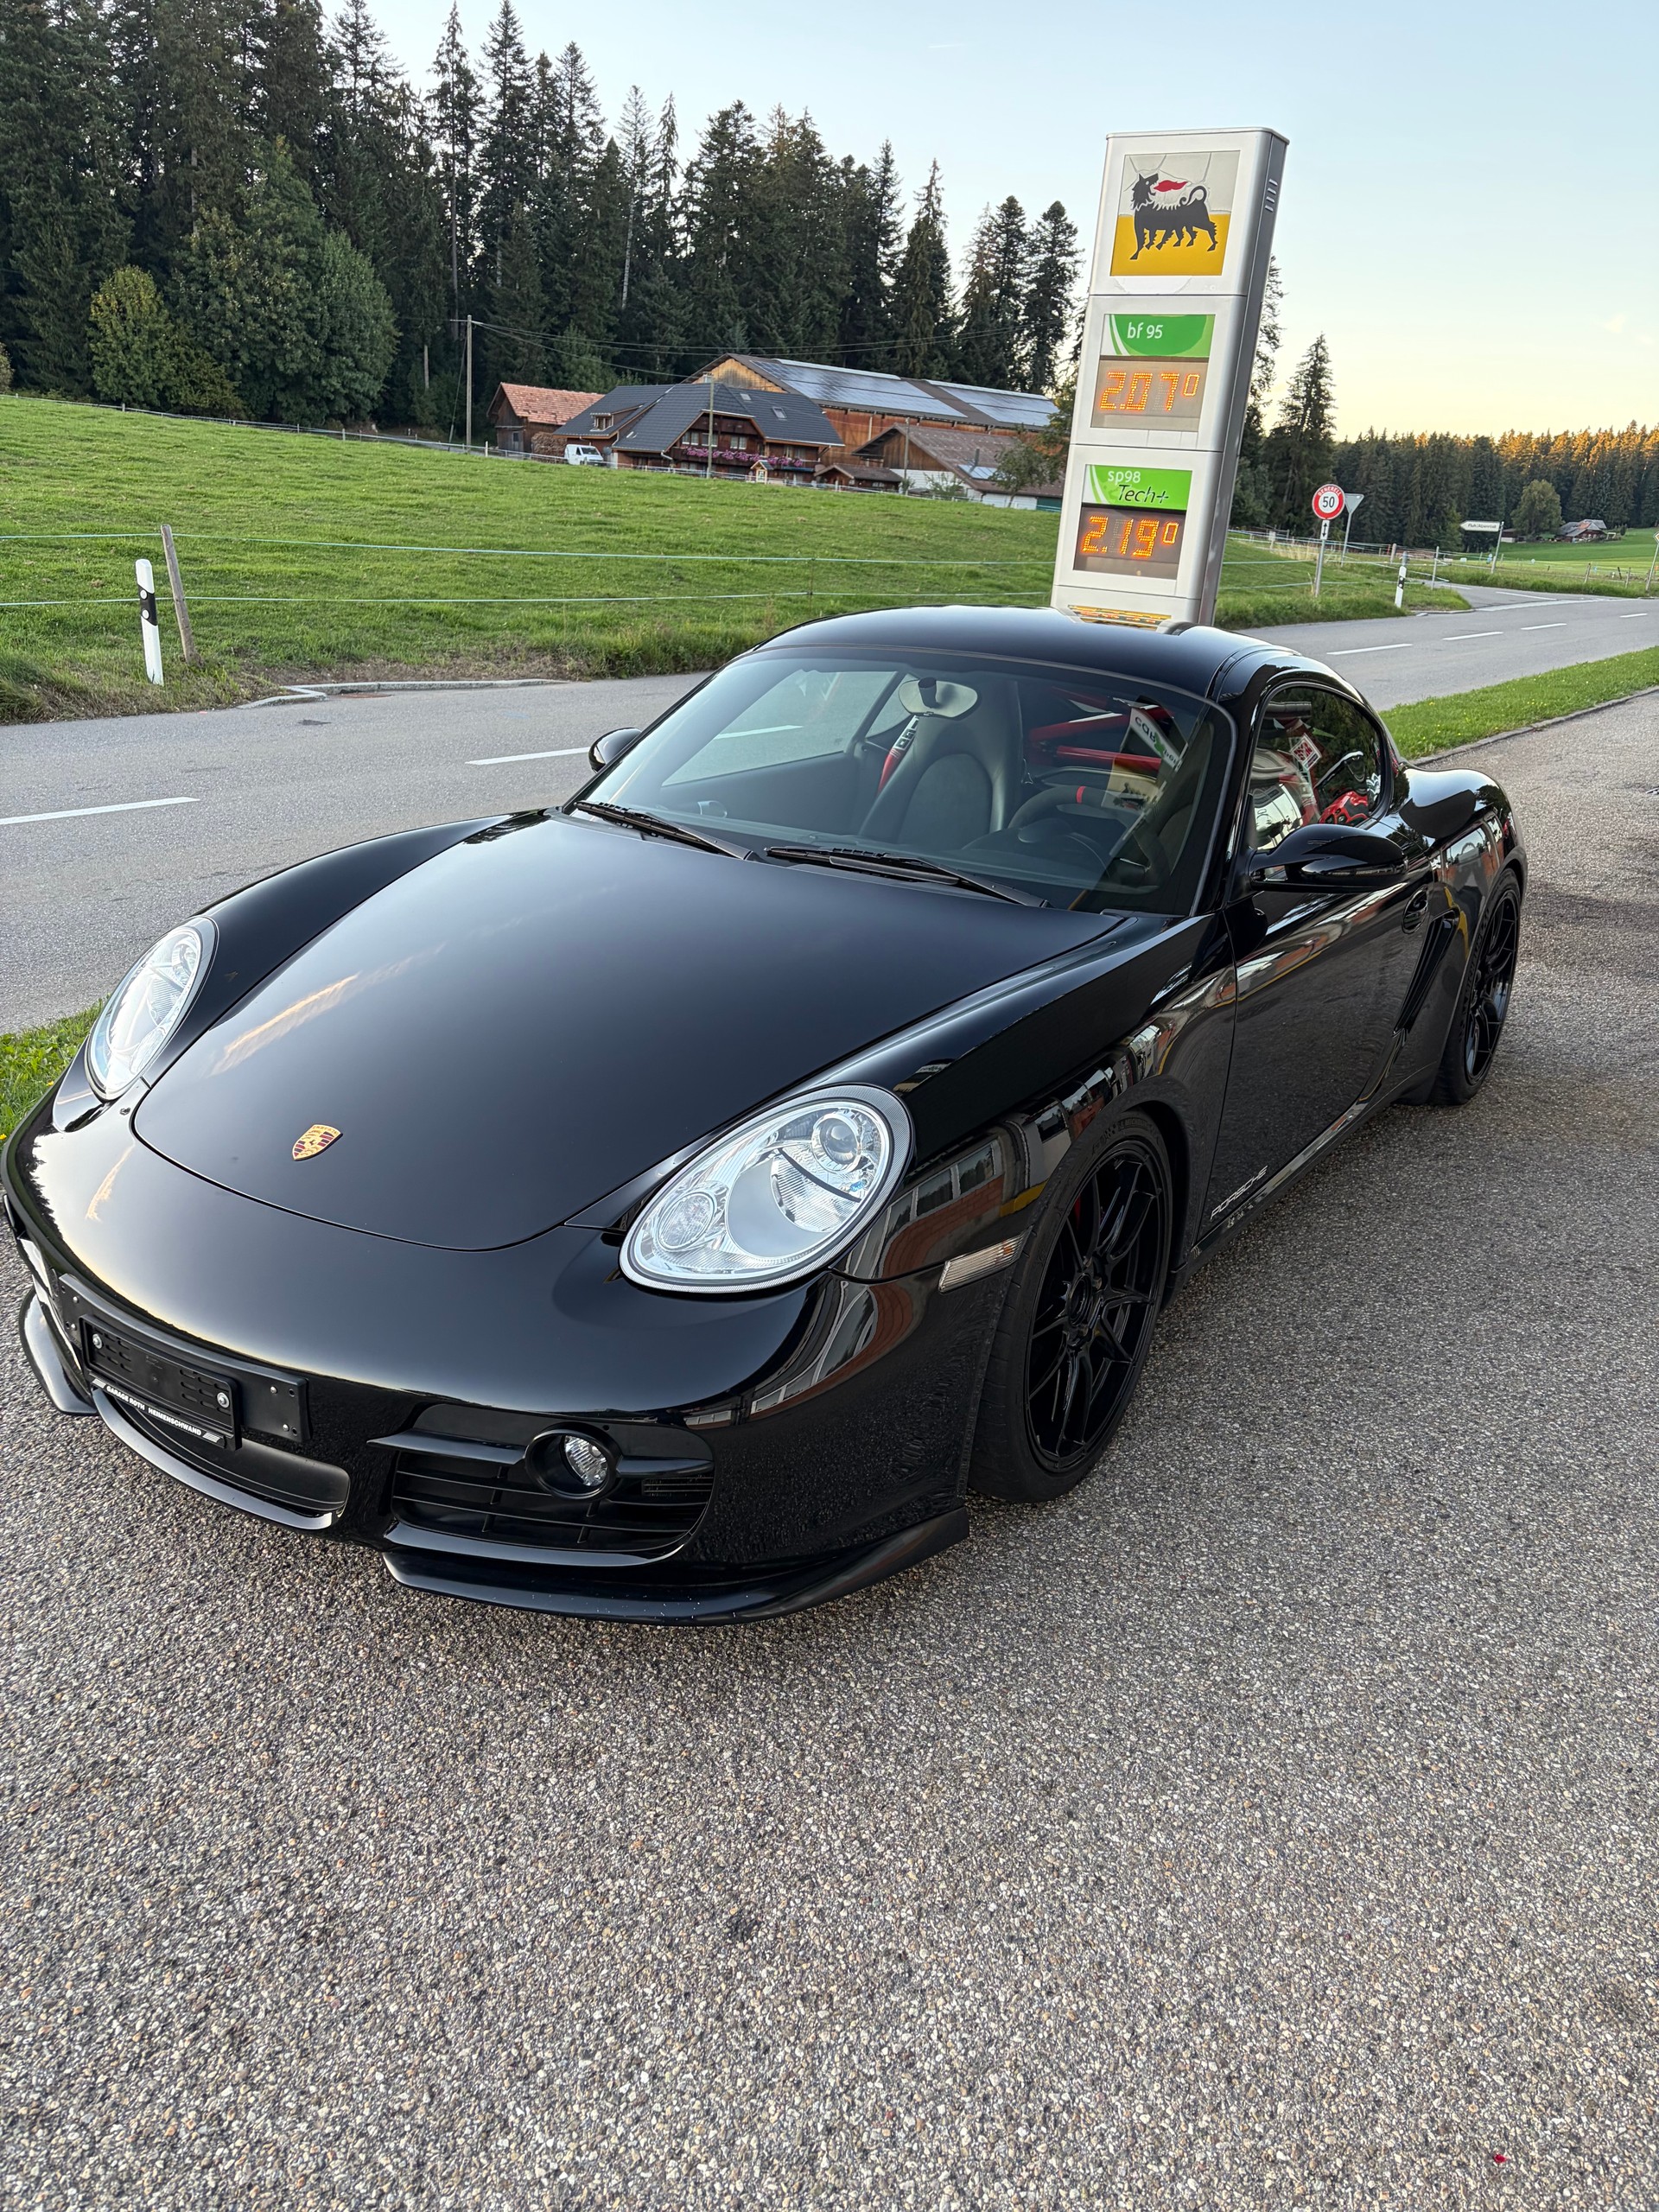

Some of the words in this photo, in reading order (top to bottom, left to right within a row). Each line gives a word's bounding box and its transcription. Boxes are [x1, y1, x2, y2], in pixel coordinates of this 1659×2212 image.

[1127, 321, 1144, 339] bf
[1146, 324, 1163, 339] 95
[1107, 470, 1141, 485] sp98
[1118, 484, 1169, 504] Tech+
[1323, 497, 1335, 508] 50
[1210, 1165, 1268, 1221] PORSCHE
[106, 1385, 129, 1402] GARAGE
[129, 1397, 145, 1411] ROTH
[148, 1407, 202, 1436] HEIMENSCHWAND
